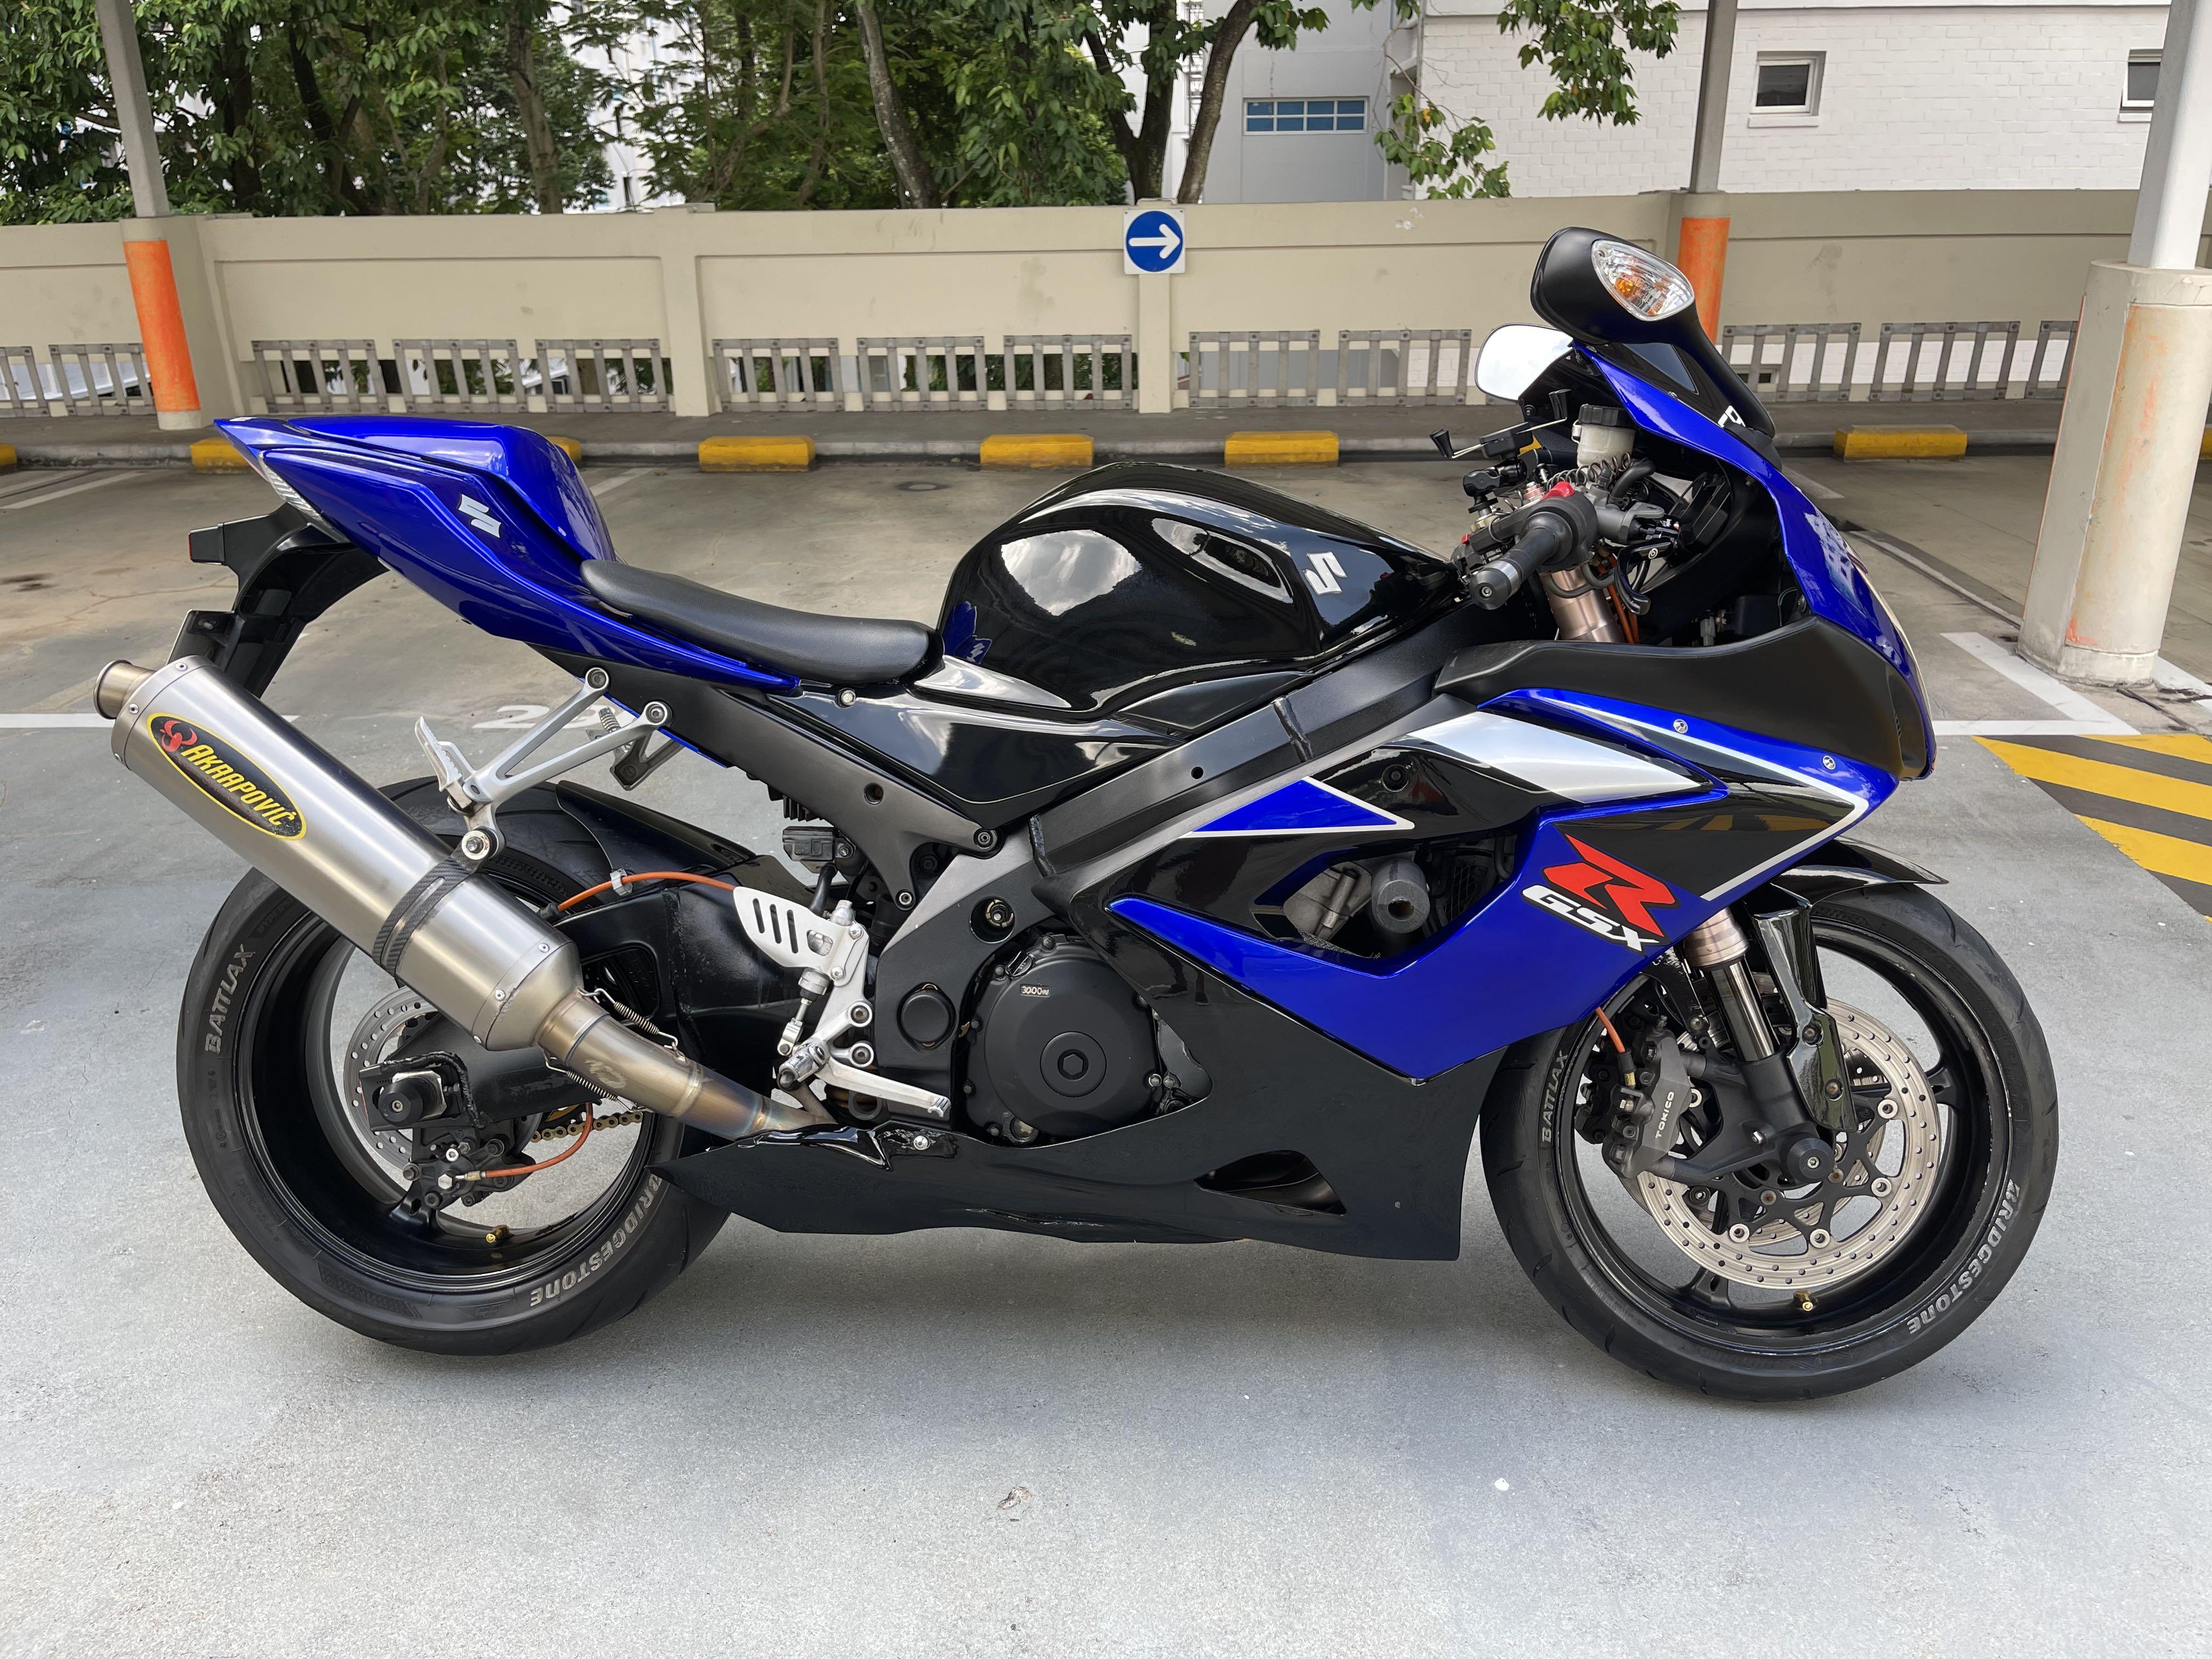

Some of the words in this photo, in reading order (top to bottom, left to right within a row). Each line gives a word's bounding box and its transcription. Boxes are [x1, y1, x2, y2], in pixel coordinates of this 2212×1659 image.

[1522, 884, 1660, 952] GSX
[1543, 833, 1676, 938] R
[205, 943, 256, 1054] BATTLAX
[1541, 1049, 1568, 1144] BATTLAX
[1655, 1091, 1675, 1139] TOKICO
[529, 1173, 663, 1307] BRIDGESTONE
[1906, 1178, 2021, 1334] BRIDGESTONE
